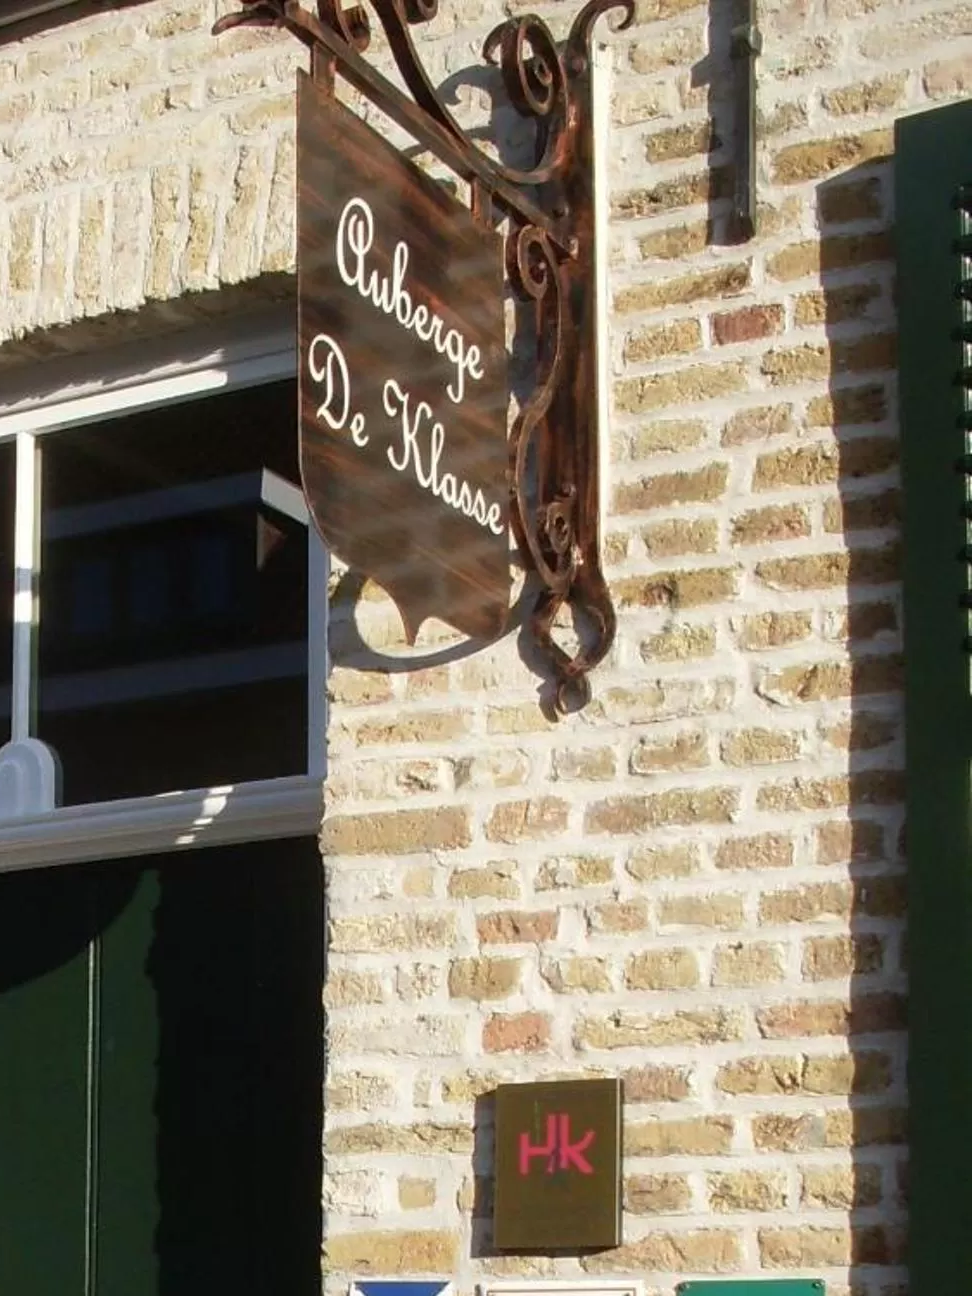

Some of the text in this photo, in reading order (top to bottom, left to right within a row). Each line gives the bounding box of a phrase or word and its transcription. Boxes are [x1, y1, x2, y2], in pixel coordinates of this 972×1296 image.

[336, 198, 484, 403] Auberge
[309, 334, 504, 535] De Klasse
